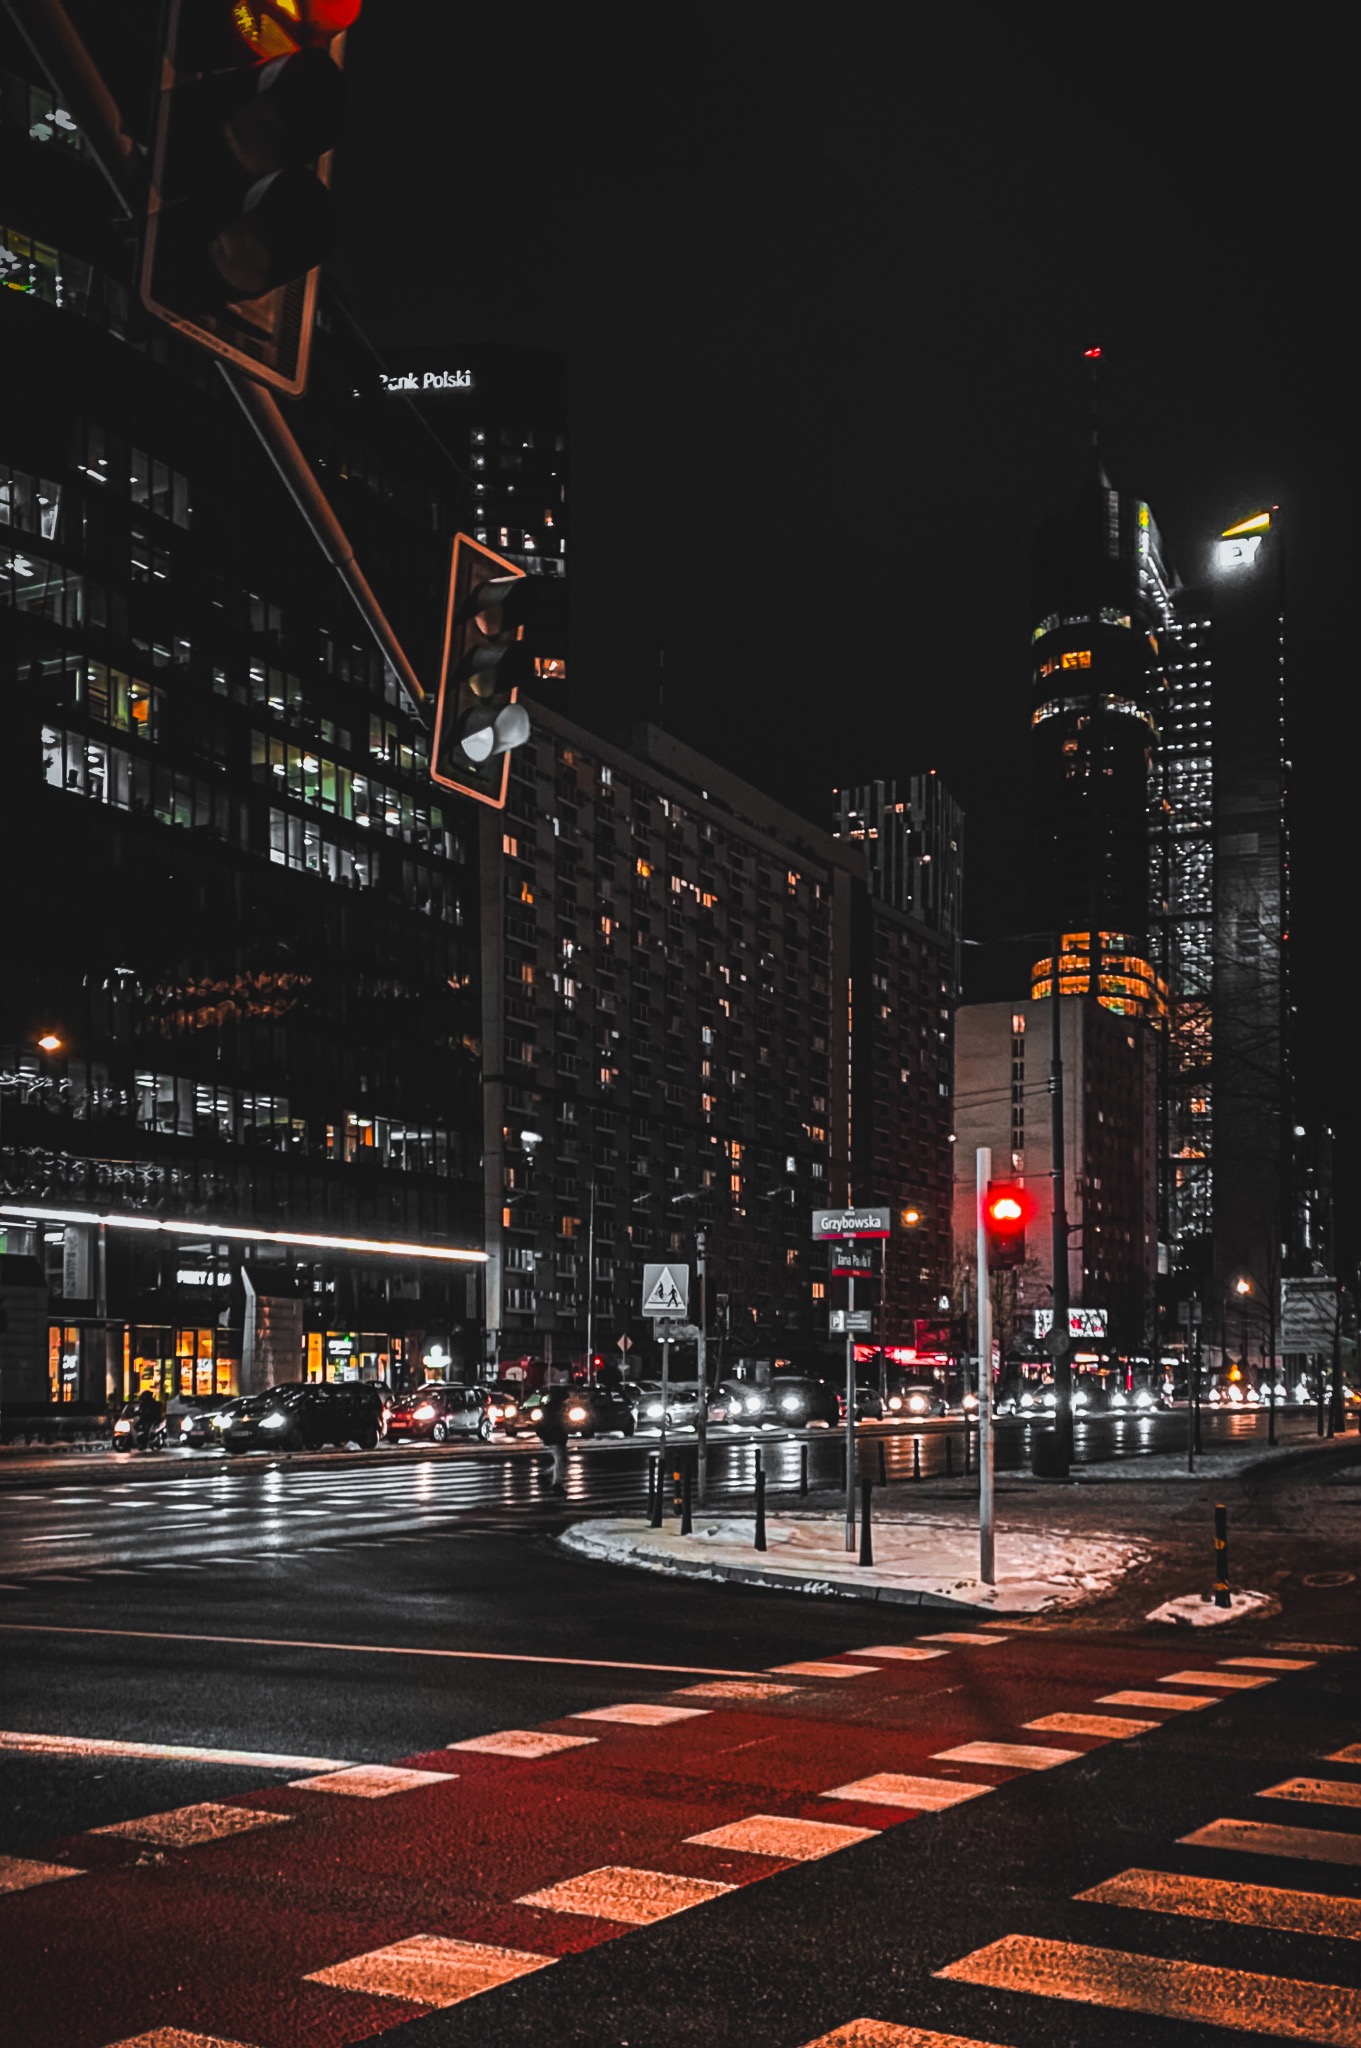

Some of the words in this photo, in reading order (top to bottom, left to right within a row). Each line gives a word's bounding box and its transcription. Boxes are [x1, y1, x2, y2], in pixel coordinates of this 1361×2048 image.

[423, 369, 471, 389] Polski
[821, 1214, 881, 1232] Grzybowska
[837, 1253, 852, 1266] Jana
